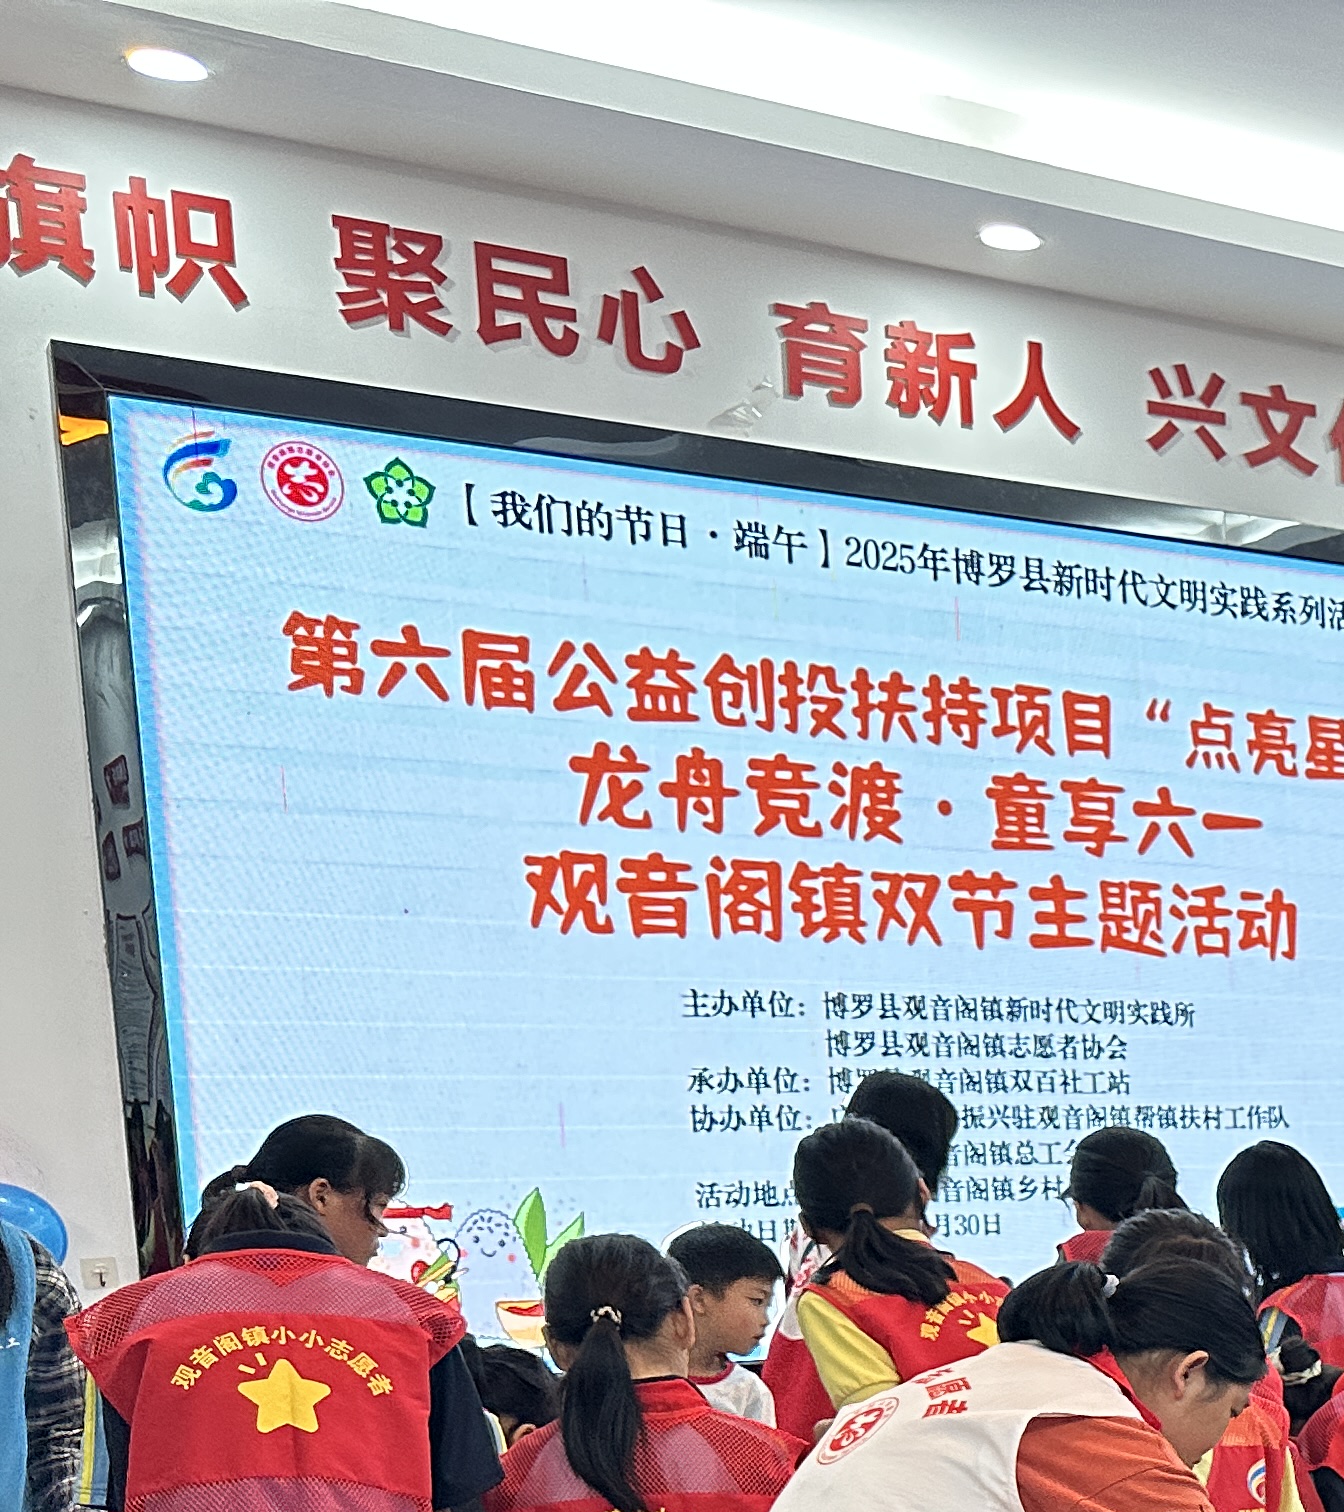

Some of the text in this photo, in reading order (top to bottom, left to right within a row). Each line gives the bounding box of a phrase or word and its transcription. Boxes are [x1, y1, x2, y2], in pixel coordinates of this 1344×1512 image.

[330, 214, 702, 375] 聚民心
[770, 301, 1082, 443] 育新人
[525, 851, 1298, 961] 观音阁镇双节主题活动
[825, 1028, 1128, 1060] 博罗县观音阁镇志愿者协会
[171, 1325, 394, 1396] 观音阁镇小小志愿者
